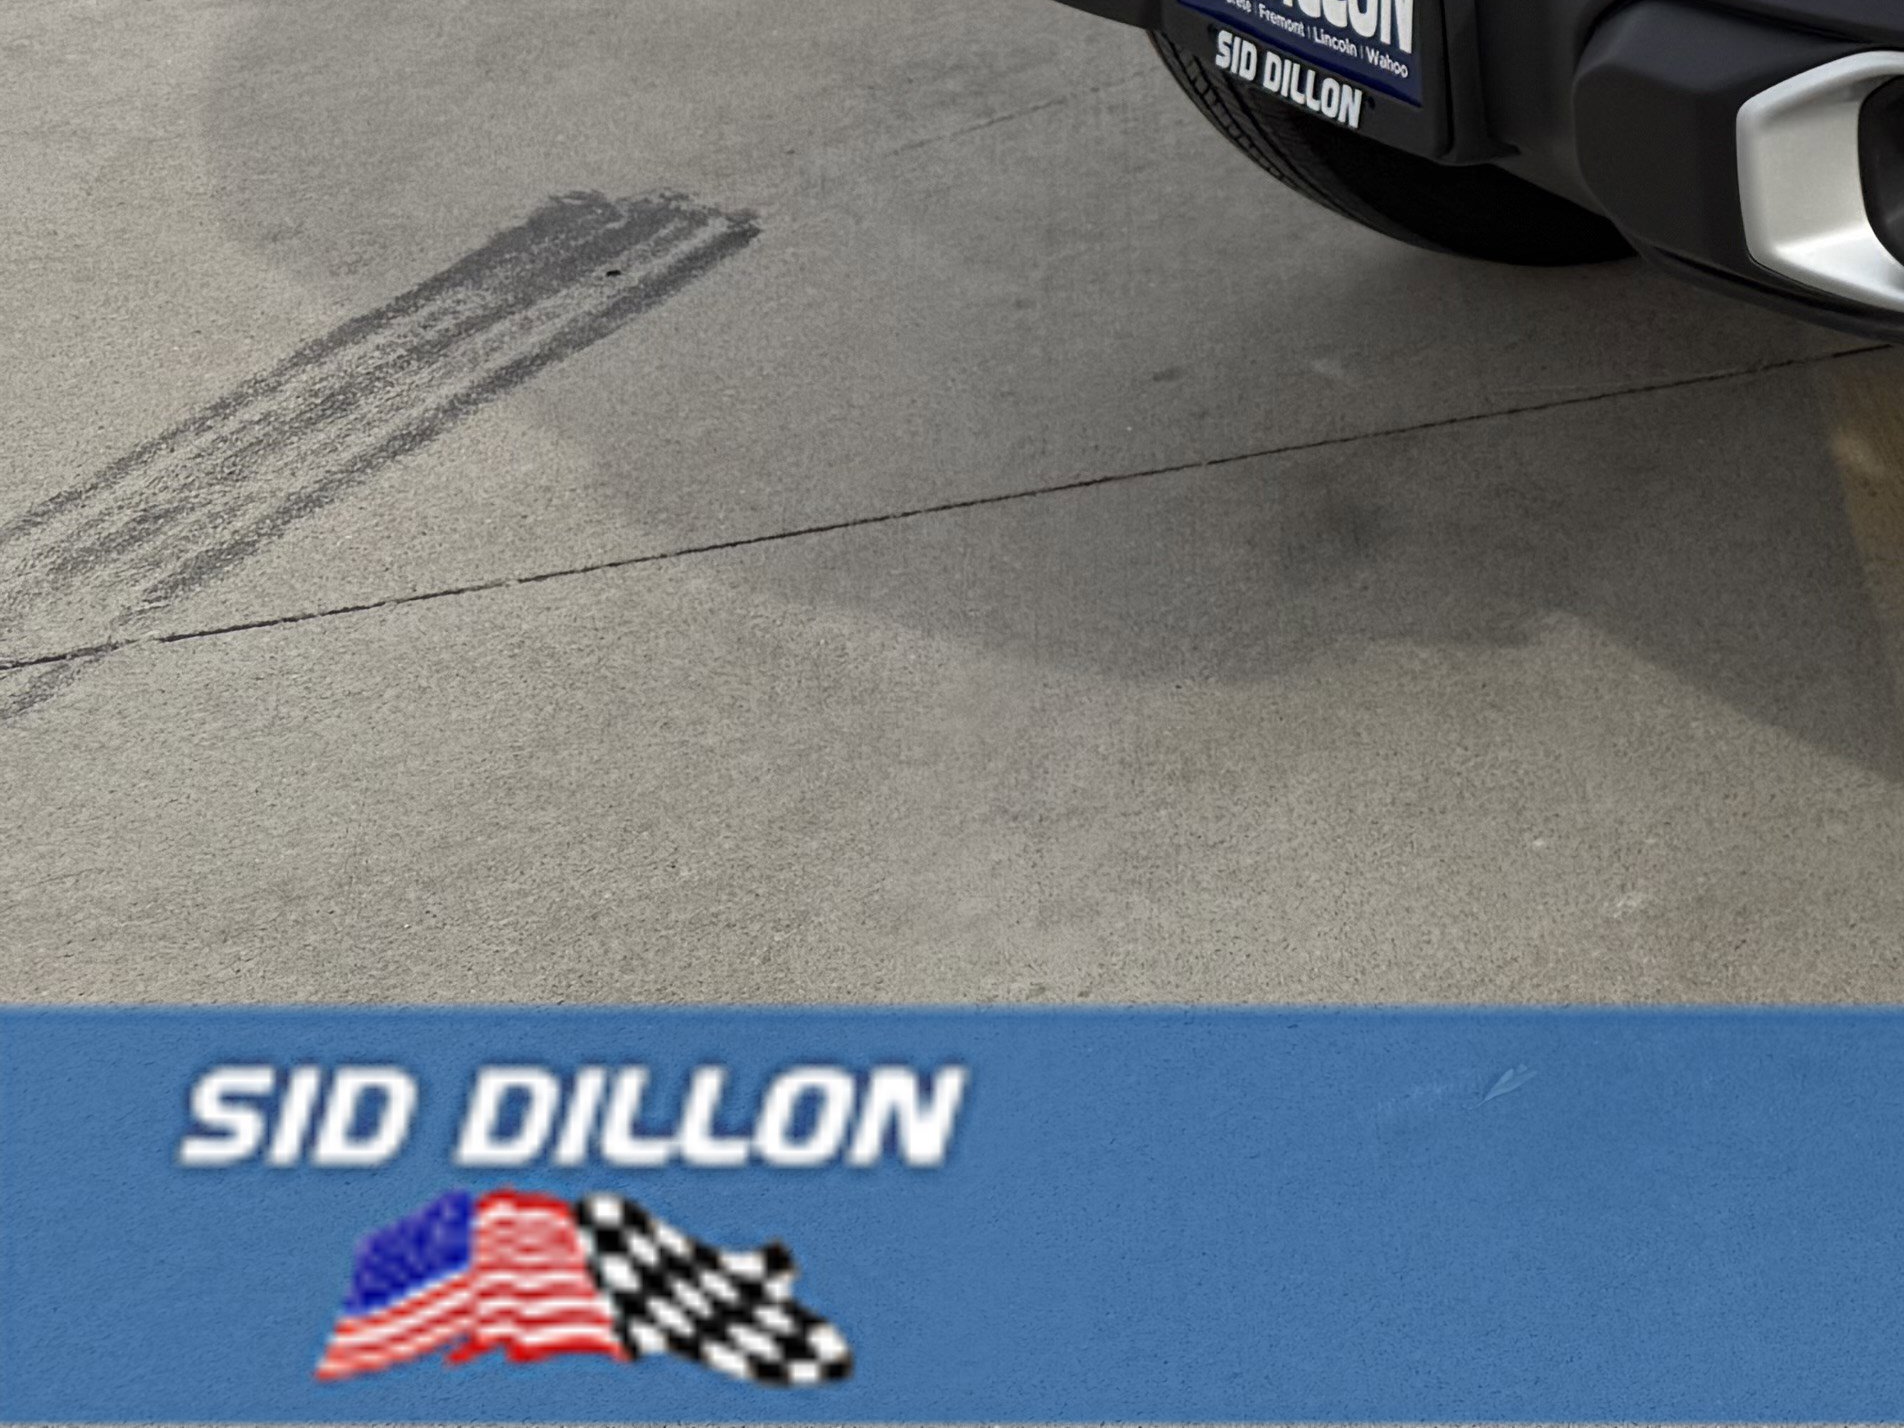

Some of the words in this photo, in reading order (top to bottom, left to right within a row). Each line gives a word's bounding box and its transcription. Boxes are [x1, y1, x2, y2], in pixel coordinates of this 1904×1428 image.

[1215, 29, 1258, 82] SID
[1262, 50, 1363, 130] DILLON
[1258, 2, 1305, 38] Fremont
[1312, 25, 1358, 59] Lincoln
[1364, 45, 1409, 79] Wahoo
